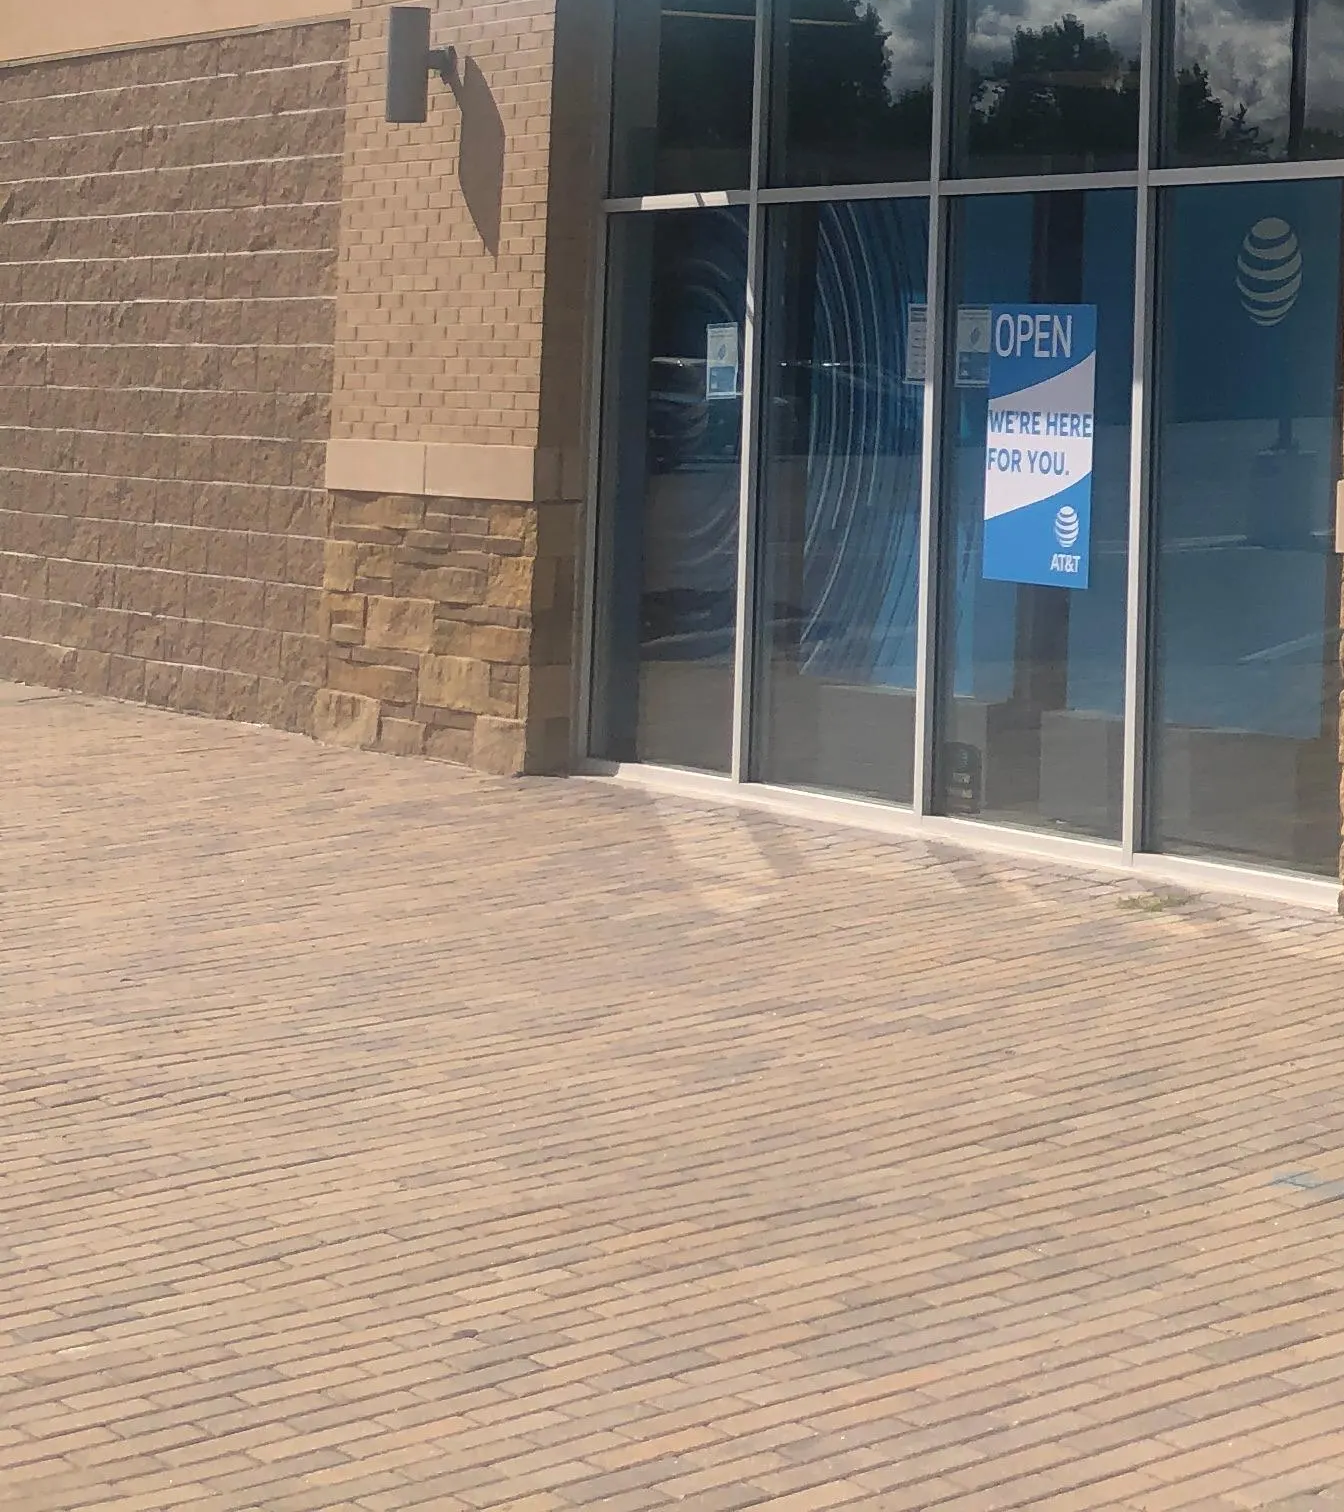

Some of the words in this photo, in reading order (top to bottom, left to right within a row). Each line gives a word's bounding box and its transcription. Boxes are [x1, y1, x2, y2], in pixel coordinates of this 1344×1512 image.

[995, 313, 1073, 358] OPEN
[988, 409, 1041, 434] WE'RE
[1046, 413, 1092, 438] HERE
[988, 448, 1021, 473] FOR
[1027, 450, 1069, 476] YOU.
[1050, 554, 1080, 573] AT&T
